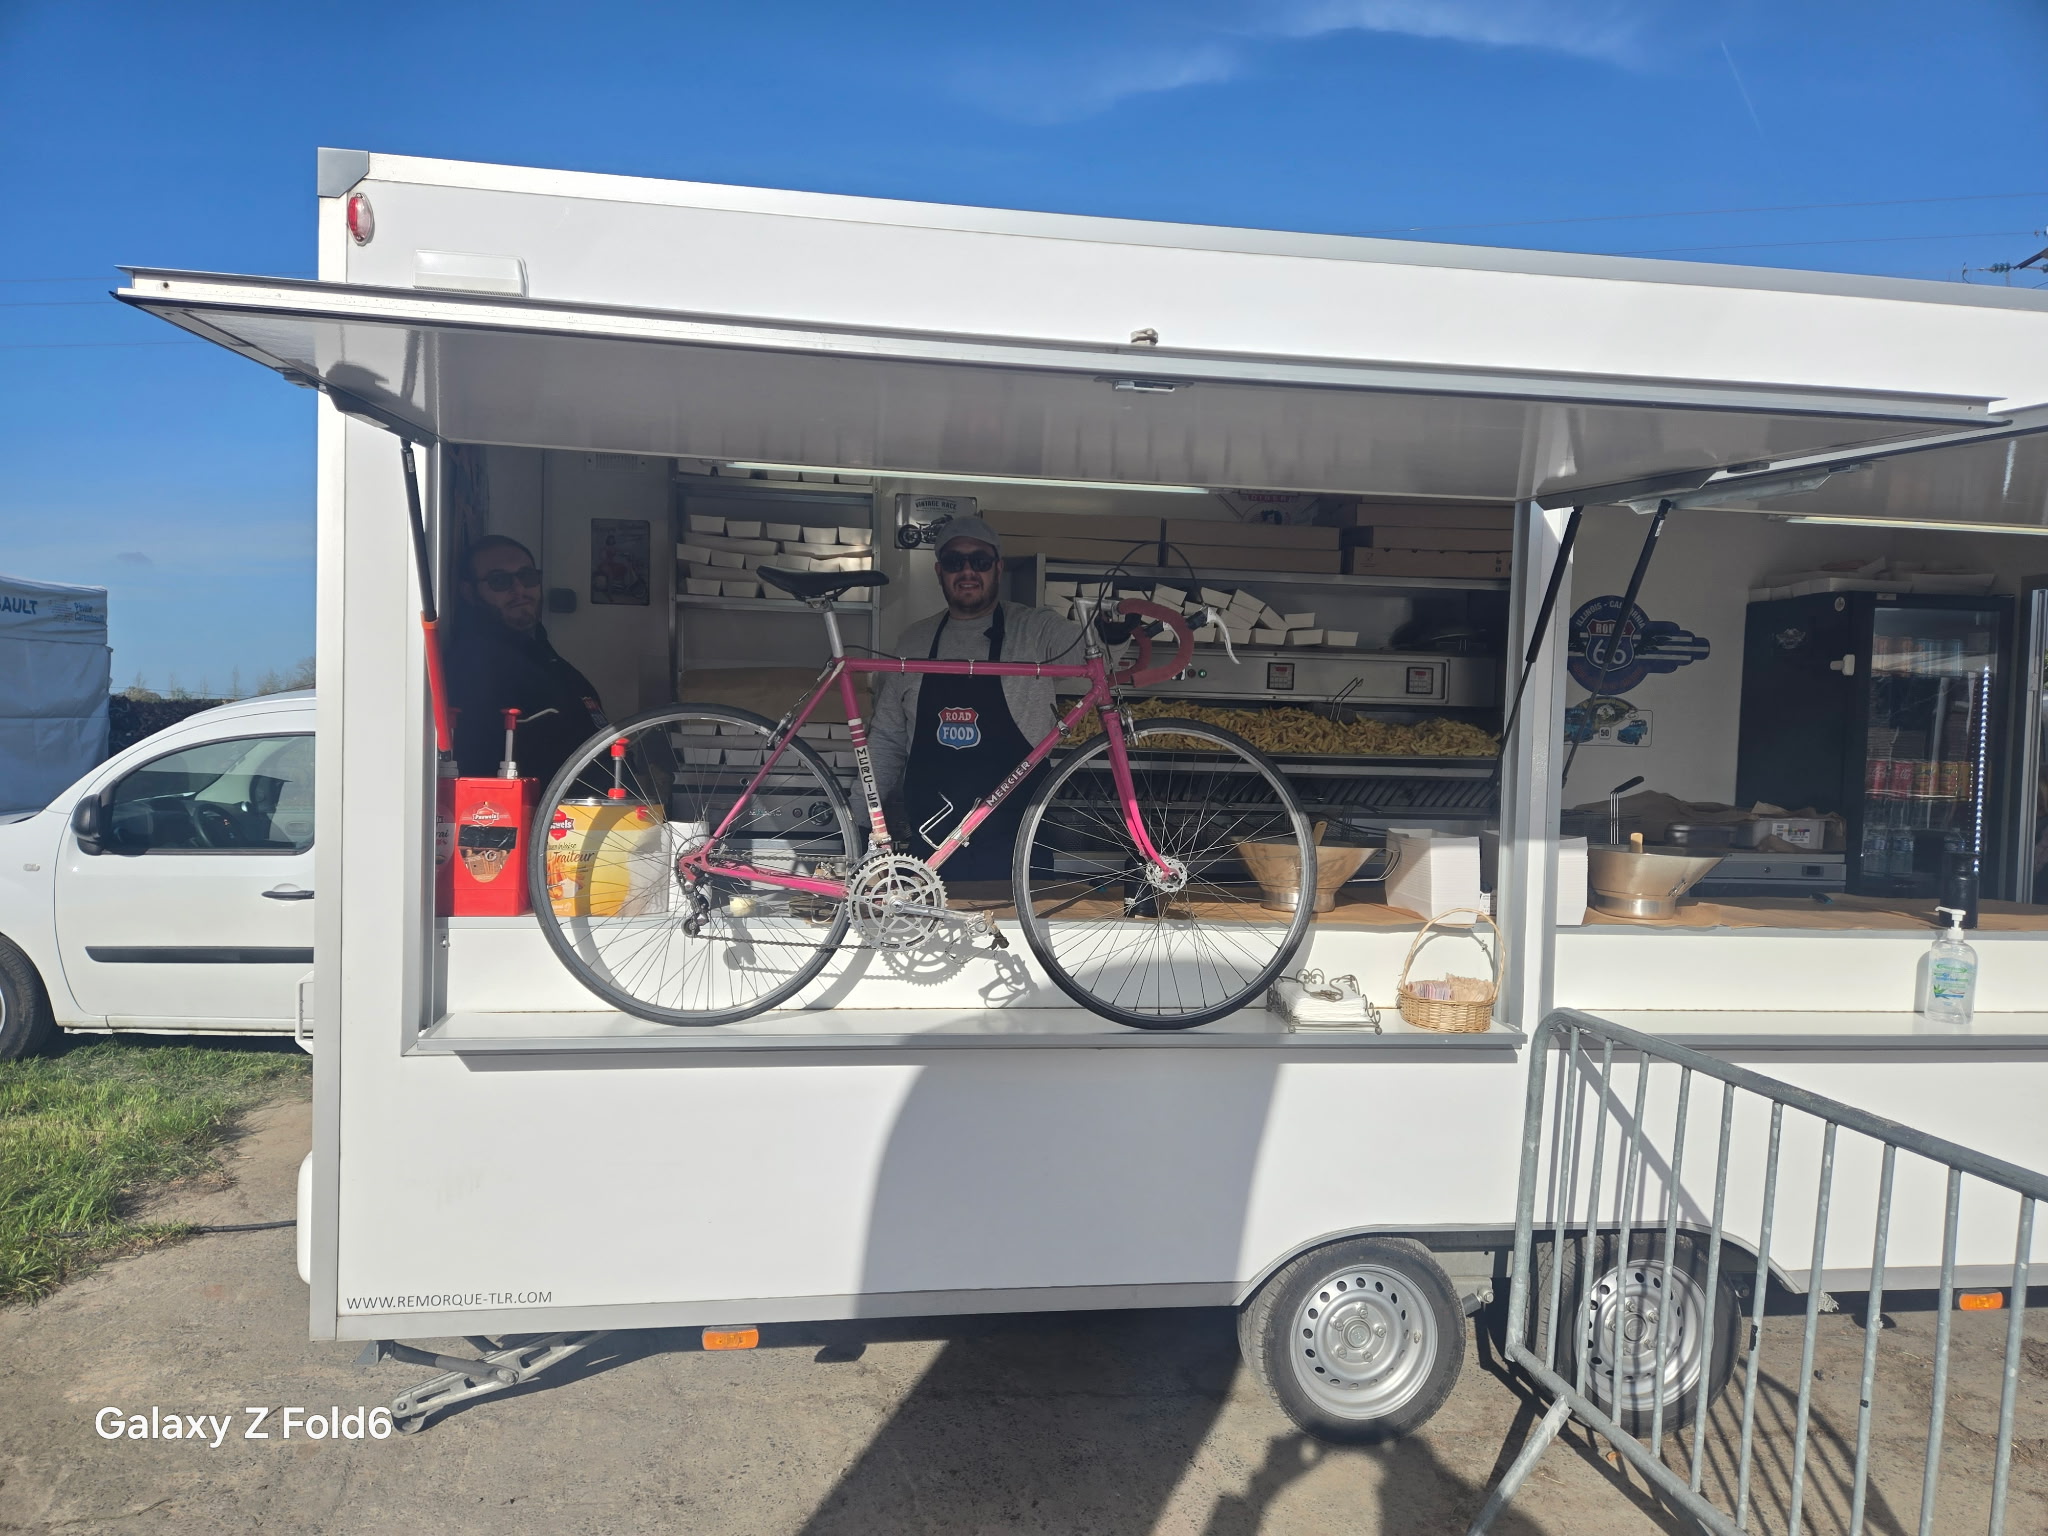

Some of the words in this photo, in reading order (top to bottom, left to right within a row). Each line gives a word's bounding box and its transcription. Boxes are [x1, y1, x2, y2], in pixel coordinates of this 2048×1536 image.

[0, 596, 38, 615] AULT
[1575, 602, 1603, 627] ILLINOIS
[1595, 623, 1627, 634] ROU
[1592, 638, 1627, 664] 66
[945, 711, 972, 721] ROAD
[942, 725, 975, 742] FOOD
[856, 747, 879, 809] MERCIER
[986, 760, 1031, 807] MERCIER
[553, 851, 595, 863] Traiteur
[347, 1291, 552, 1309] WWW.REMORQUE-TLR.COM
